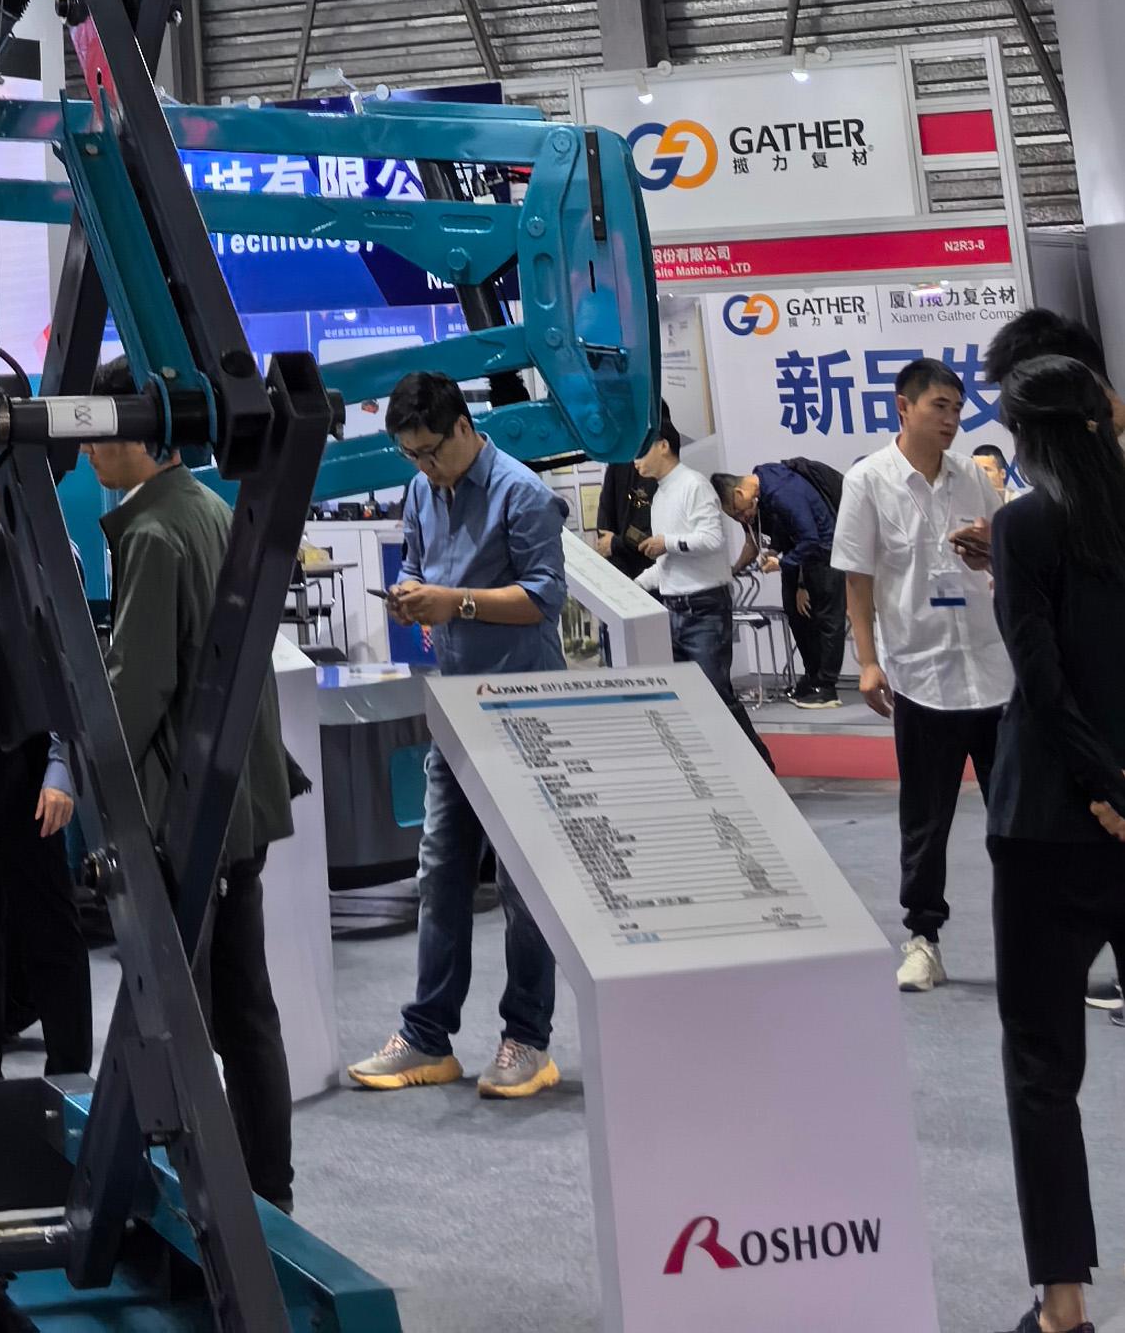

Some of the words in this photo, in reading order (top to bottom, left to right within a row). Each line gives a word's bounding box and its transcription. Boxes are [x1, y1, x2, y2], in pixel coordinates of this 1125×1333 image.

[729, 118, 866, 155] GATHER
[944, 239, 985, 252] N2R3-8
[730, 262, 752, 274] LTD
[786, 295, 865, 317] GATHER
[891, 311, 934, 324] Xiamen
[937, 309, 976, 321] Gather
[663, 1215, 881, 1275] ROSHOW
